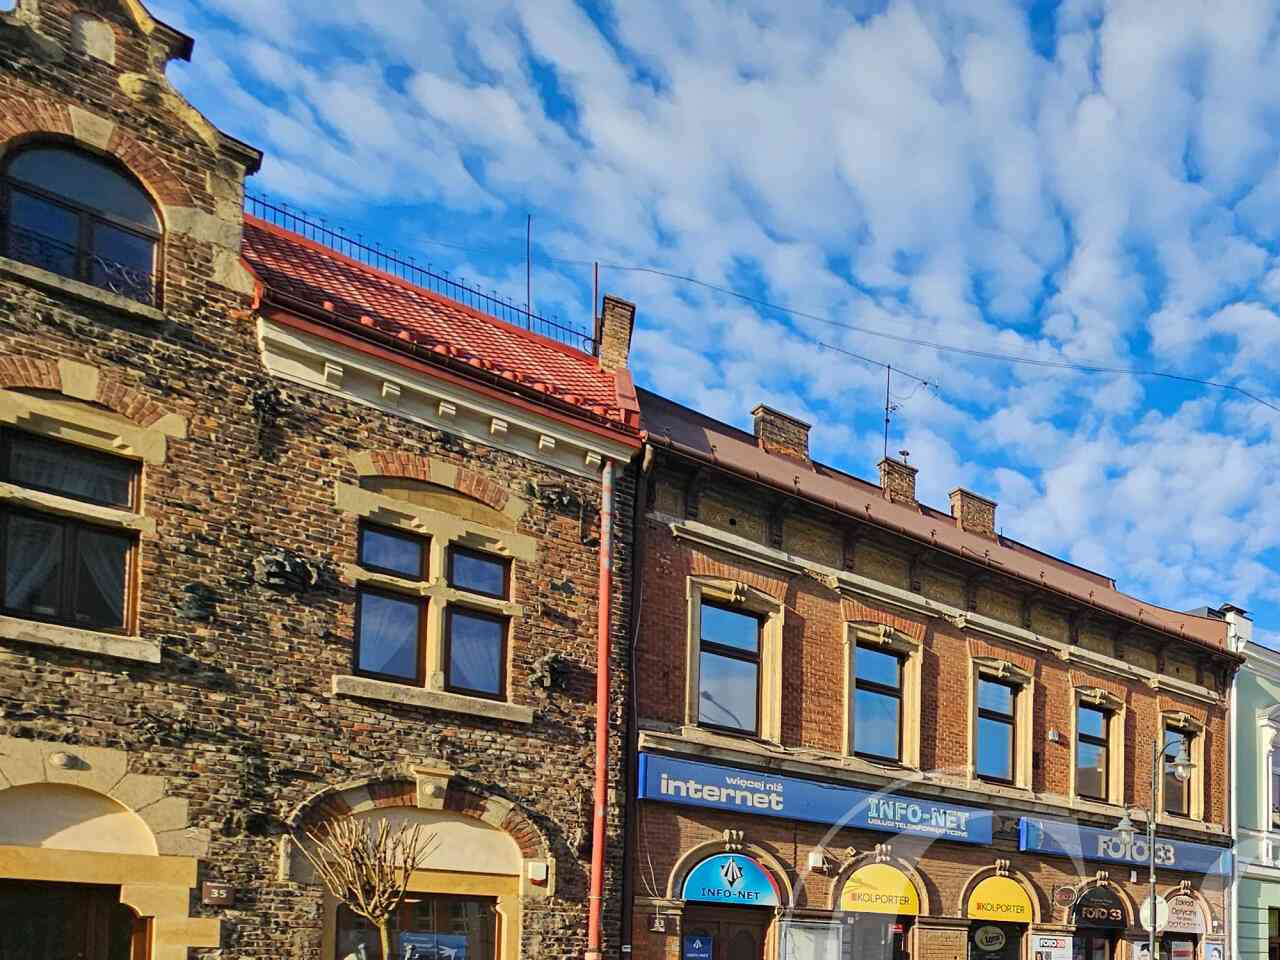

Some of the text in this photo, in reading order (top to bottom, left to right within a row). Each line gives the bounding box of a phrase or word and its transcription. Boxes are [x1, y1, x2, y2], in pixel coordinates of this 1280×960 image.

[660, 773, 784, 811] internet
[867, 797, 969, 831] INFO-NET
[1097, 834, 1150, 862] FOTO
[209, 889, 227, 898] 35
[701, 887, 760, 901] INFO-NET
[856, 892, 911, 906] KOLPORTER
[981, 902, 1025, 914] KOLPORTER
[1082, 907, 1122, 920] FOTO 33
